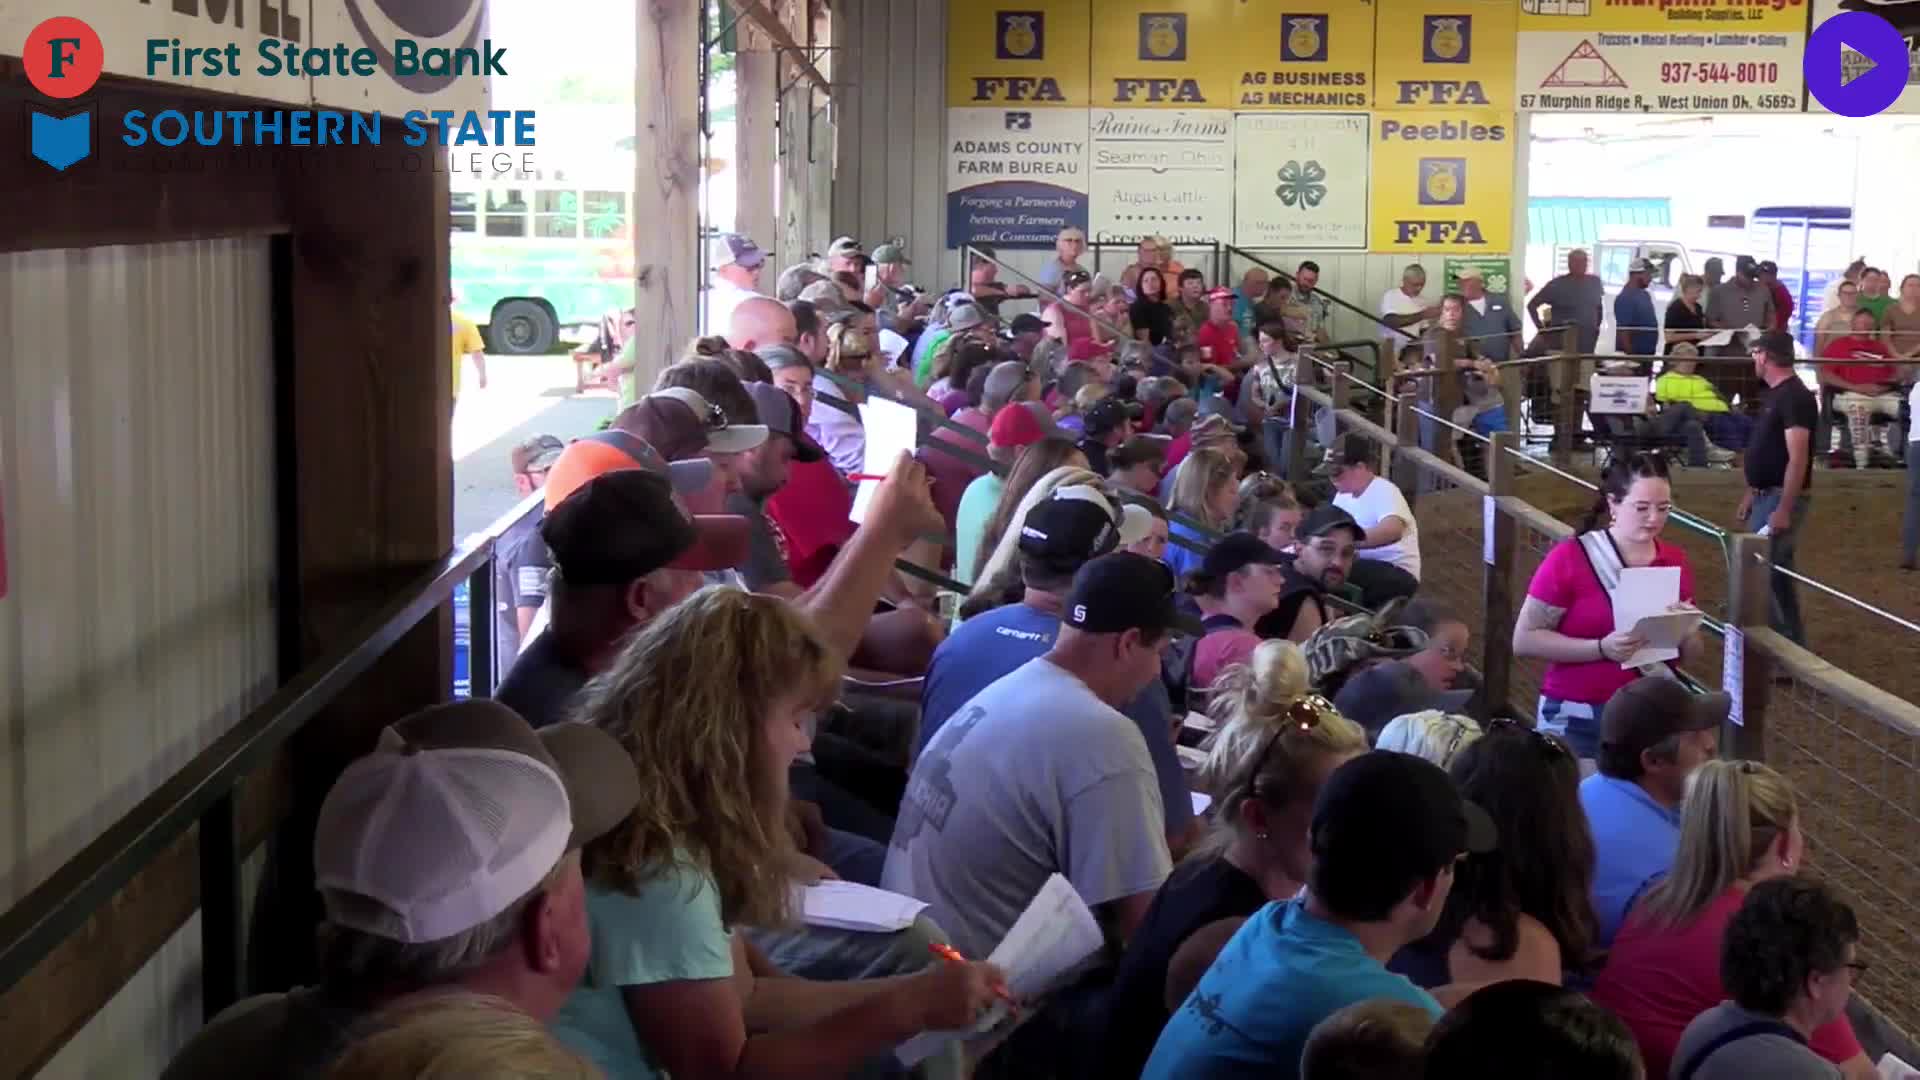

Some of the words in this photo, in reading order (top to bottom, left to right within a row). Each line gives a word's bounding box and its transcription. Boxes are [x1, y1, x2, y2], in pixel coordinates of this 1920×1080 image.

[1748, 9, 1763, 19] LLC
[1241, 72, 1266, 85] AG
[1273, 72, 1365, 86] BUSINESS
[1660, 63, 1778, 83] 937-544-8010
[972, 77, 1066, 100] FFA
[1113, 78, 1206, 102] FFA
[1396, 80, 1489, 105] FFA
[1241, 92, 1266, 105] AG
[1269, 92, 1365, 106] MECHANICS
[1540, 94, 1591, 110] Murphin
[1596, 94, 1630, 110] Ridge
[1658, 95, 1688, 109] West
[1693, 95, 1728, 109] Union
[1164, 112, 1227, 135] Farms
[1381, 120, 1505, 141] Peebles
[953, 141, 1010, 154] ADAMS
[1016, 141, 1082, 154] COUNTY
[958, 161, 1003, 174] FARM
[1009, 161, 1078, 174] BUREAU
[960, 196, 1004, 208] Forging
[1015, 196, 1077, 208] Partnership
[970, 214, 1014, 225] between
[1018, 215, 1065, 225] Farmers
[972, 231, 996, 241] and
[1000, 231, 1057, 241] Consume
[1096, 231, 1218, 243] Greeouses
[1394, 220, 1487, 245] FFA
